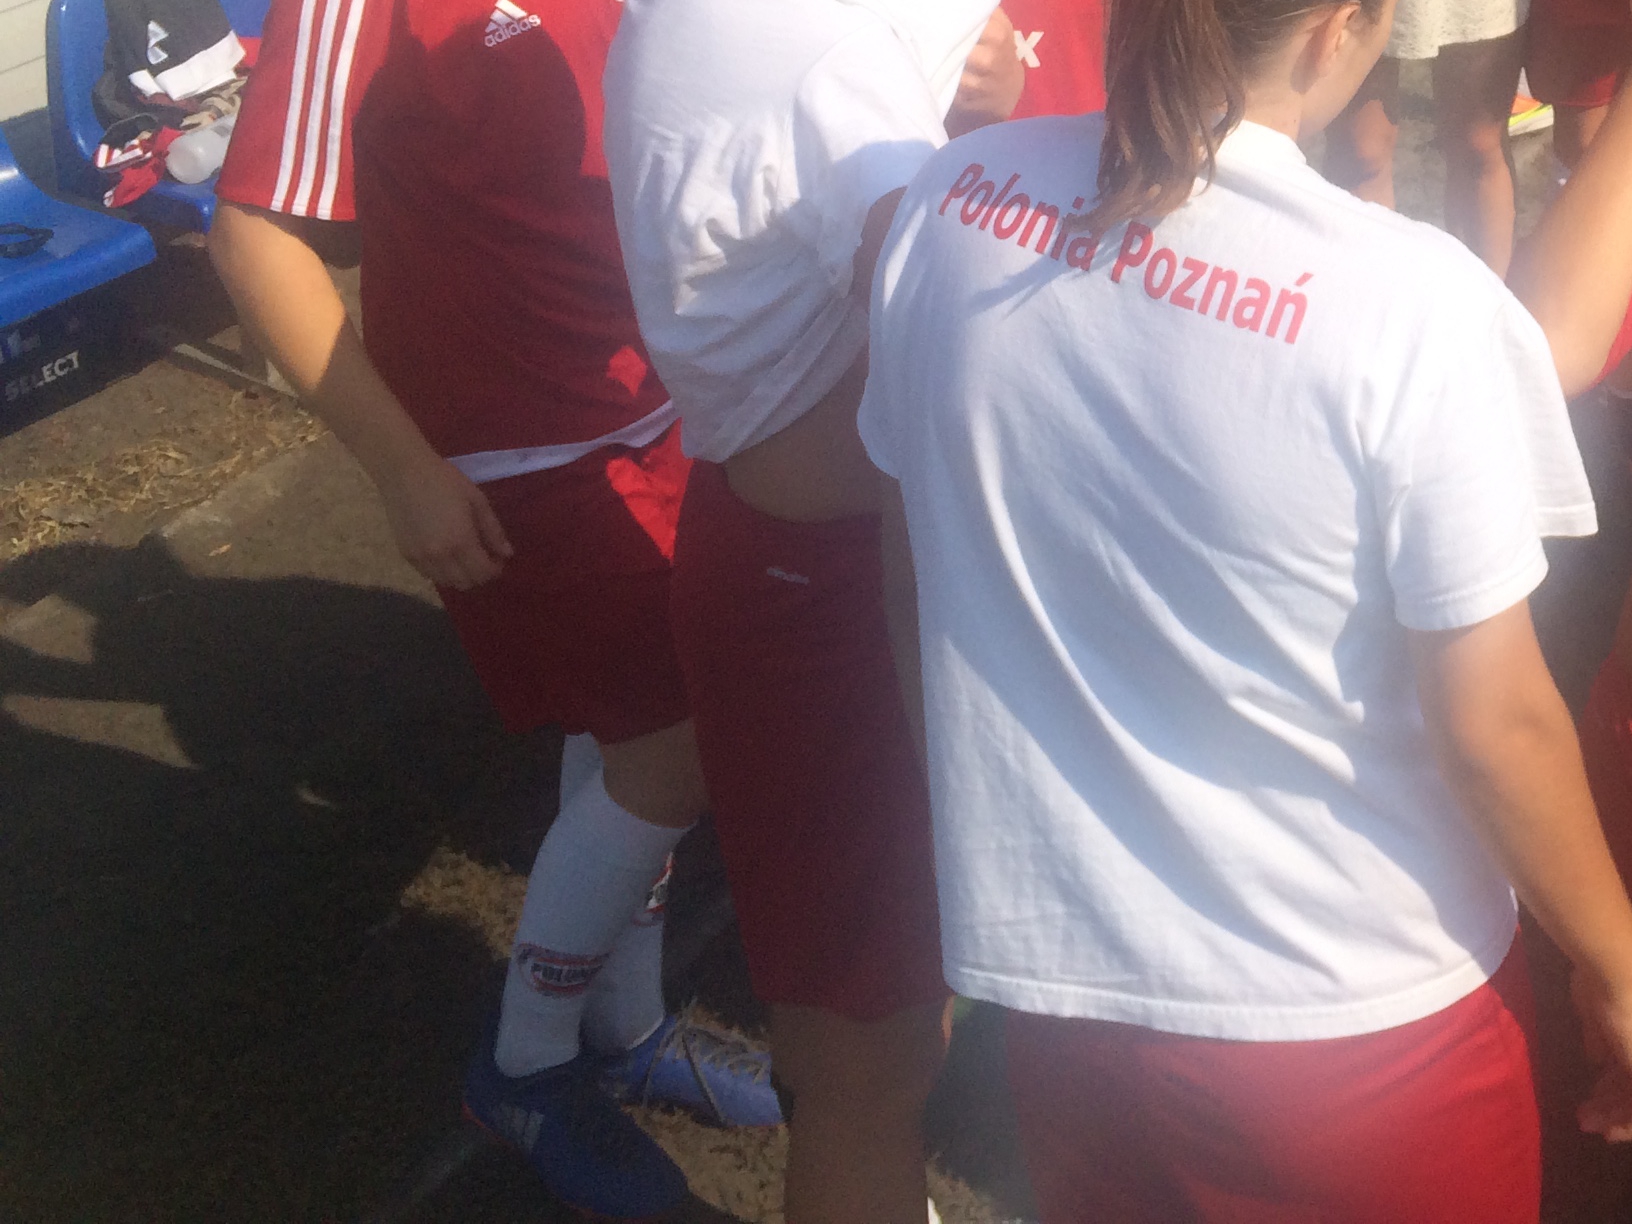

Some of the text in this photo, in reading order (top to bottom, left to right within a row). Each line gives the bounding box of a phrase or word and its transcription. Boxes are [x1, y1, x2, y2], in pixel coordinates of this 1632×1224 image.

[484, 13, 542, 48] adidas
[938, 162, 1314, 345] Polonia Poznań
